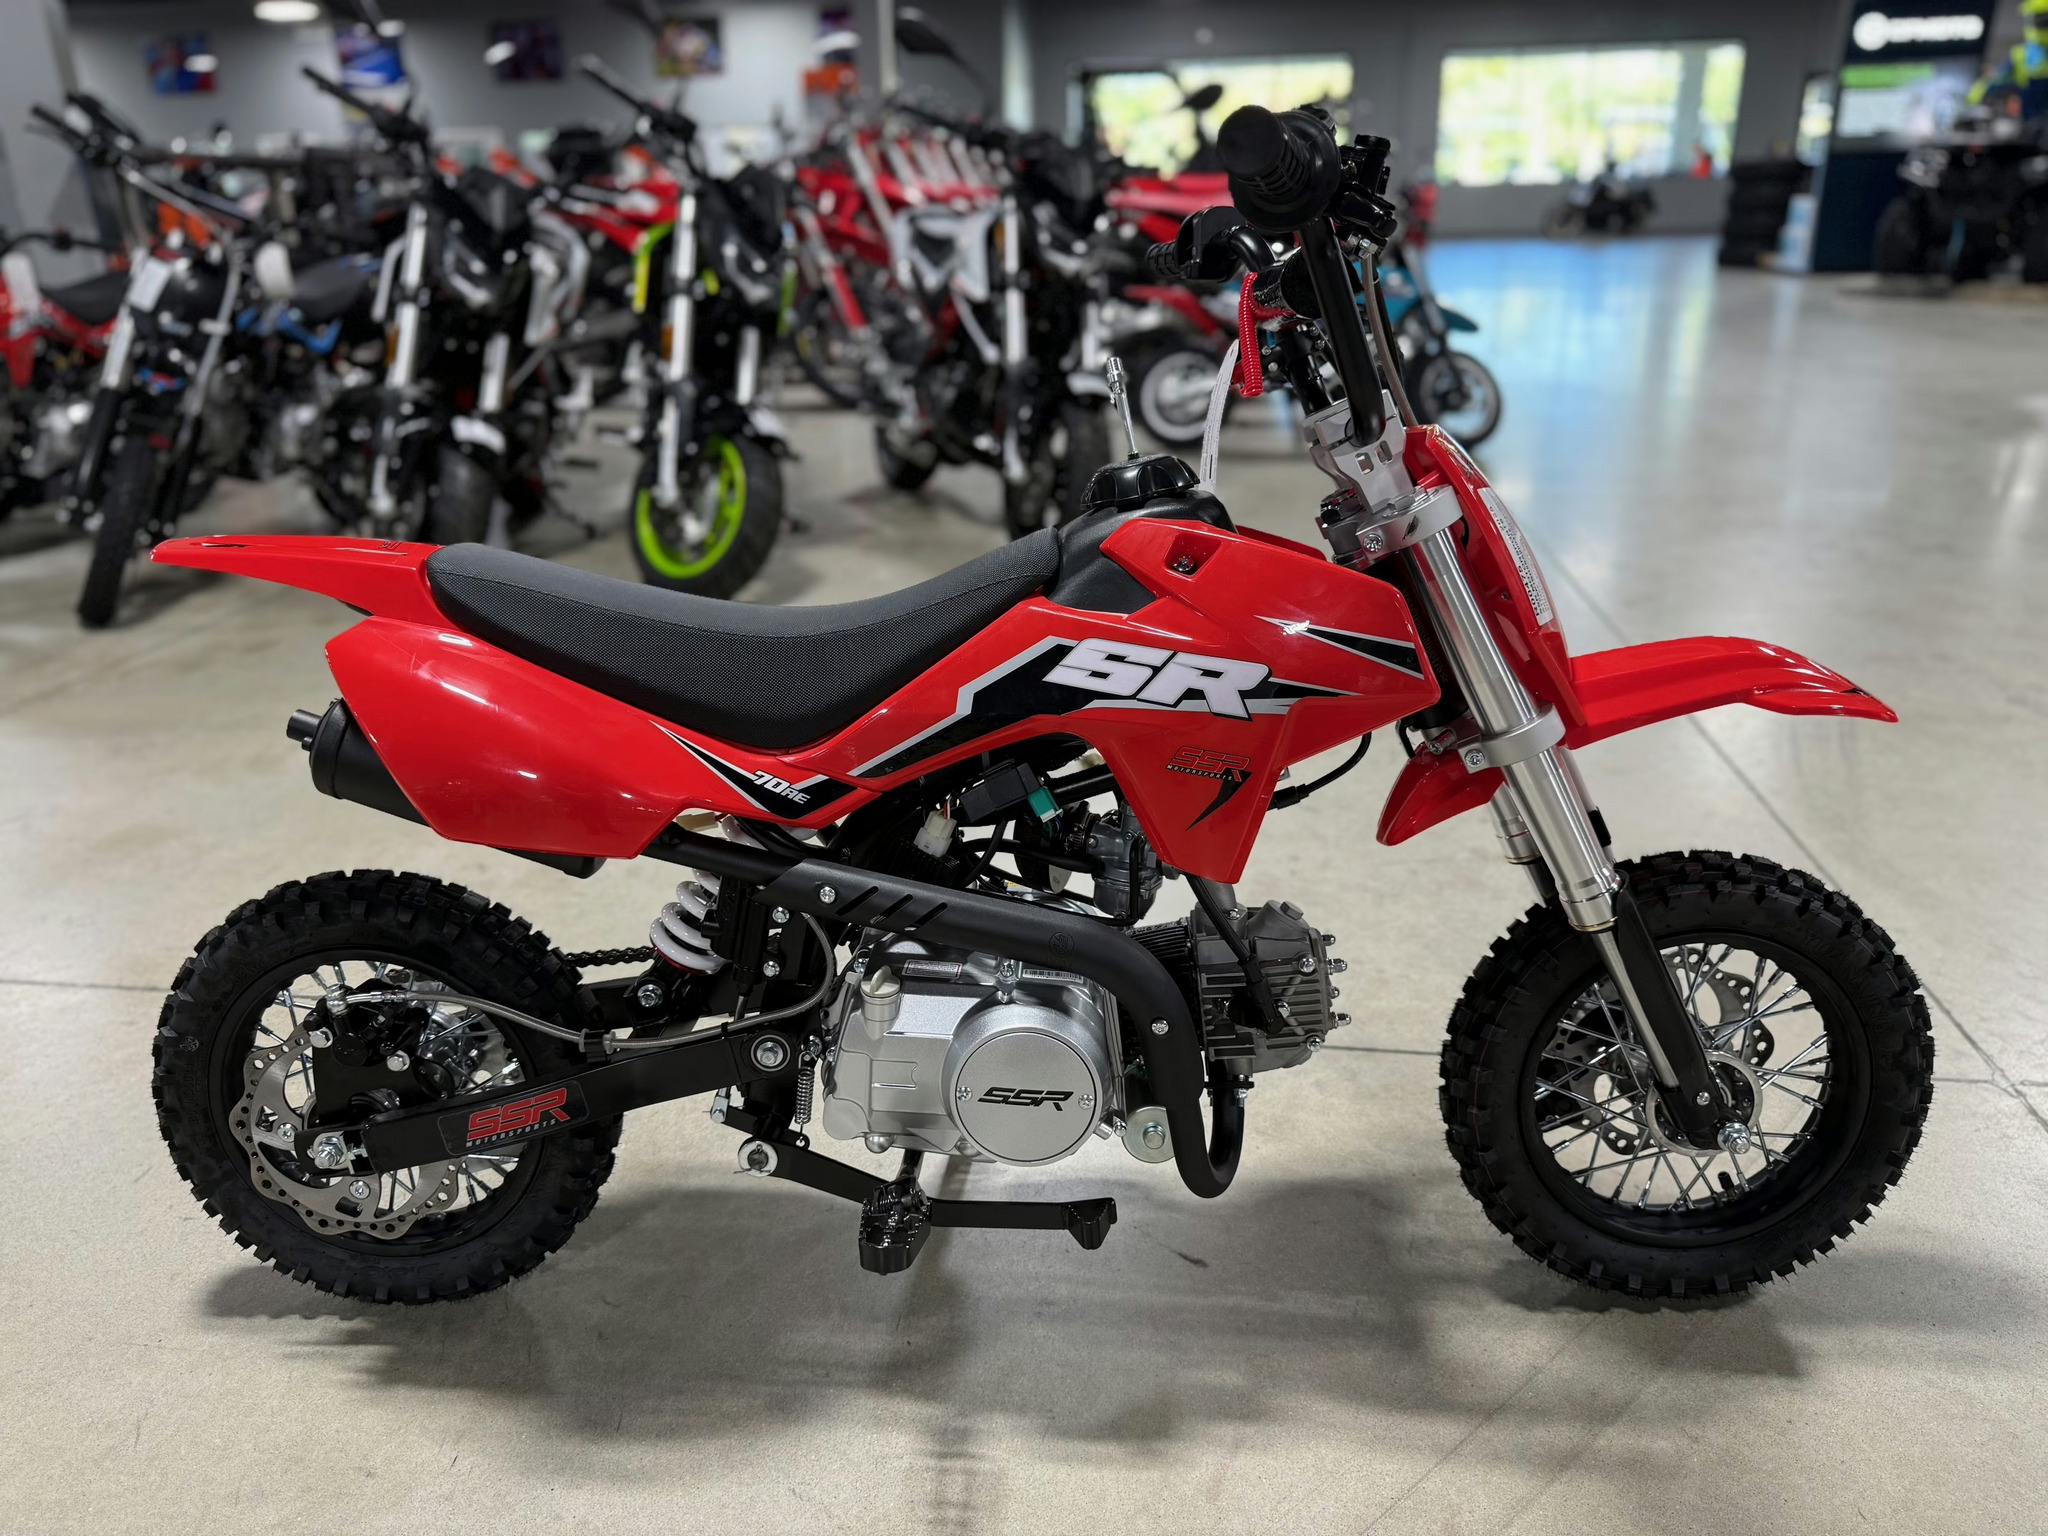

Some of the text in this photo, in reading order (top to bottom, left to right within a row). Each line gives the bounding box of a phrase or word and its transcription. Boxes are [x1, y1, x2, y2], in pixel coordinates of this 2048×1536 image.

[1042, 637, 1270, 719] SR
[1166, 763, 1233, 781] MOTORSPORTS
[467, 1087, 571, 1140] SSR
[977, 1086, 1074, 1112] SSR
[466, 1118, 556, 1148] MOTORSPORTS
